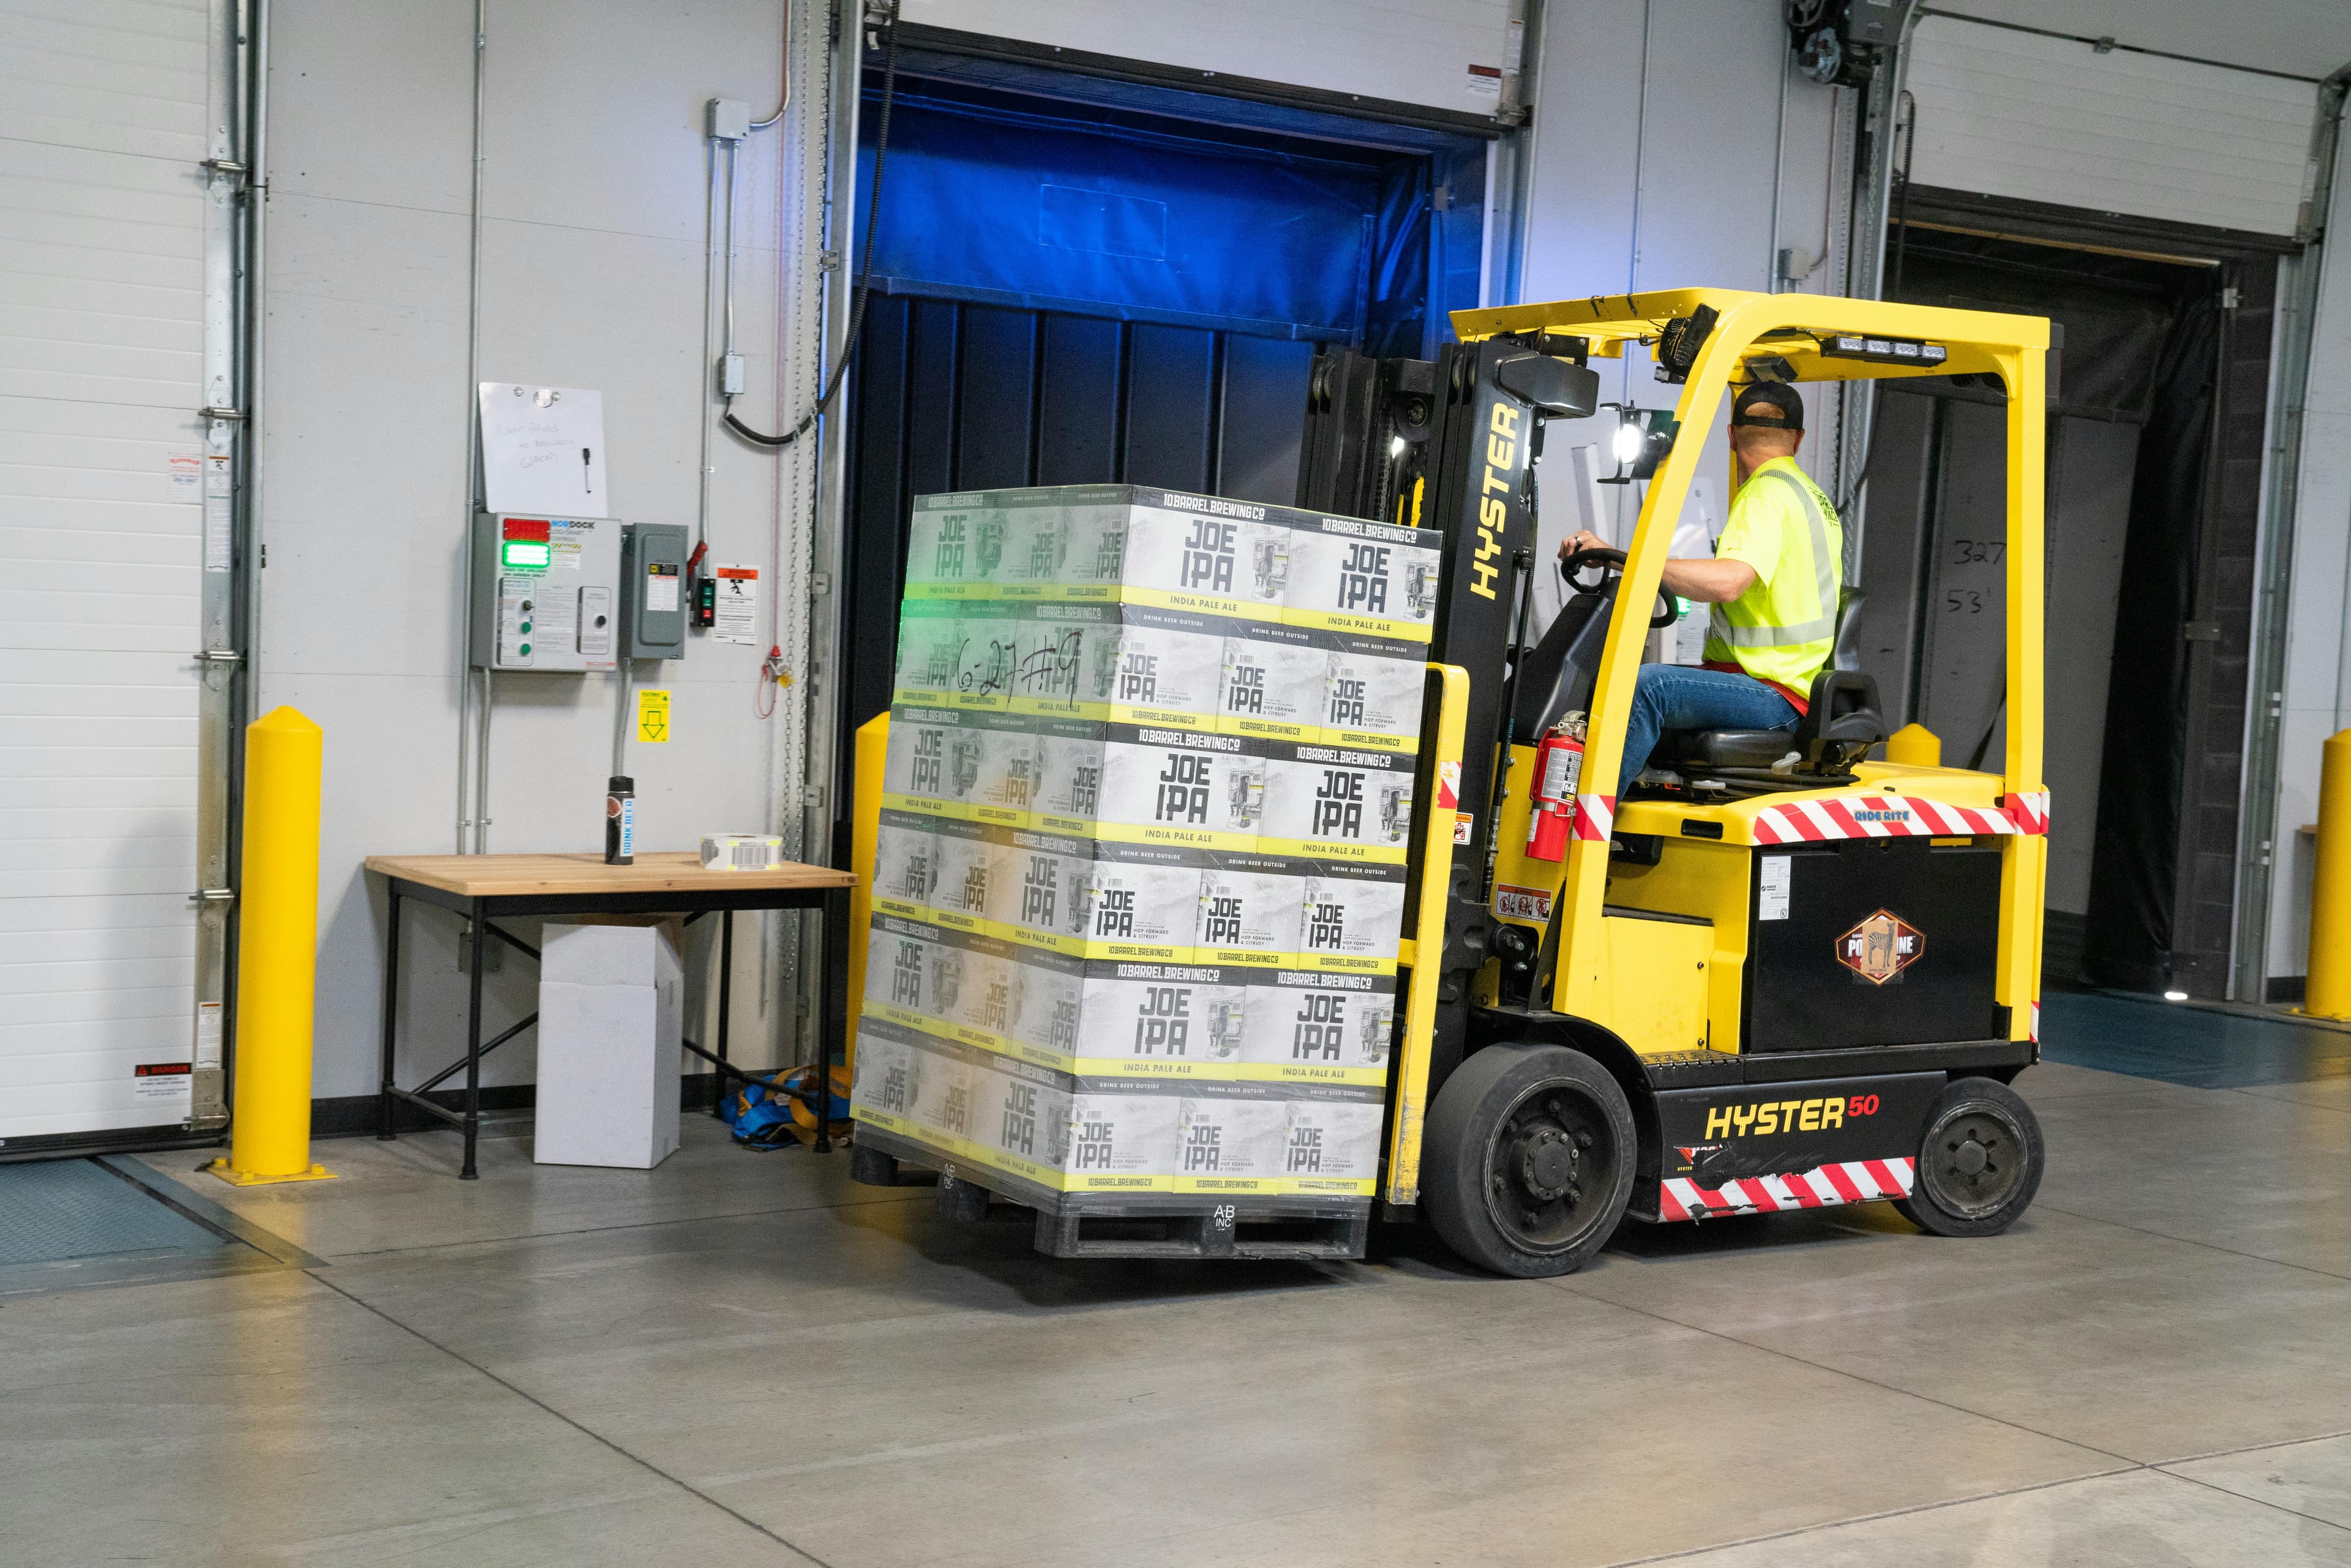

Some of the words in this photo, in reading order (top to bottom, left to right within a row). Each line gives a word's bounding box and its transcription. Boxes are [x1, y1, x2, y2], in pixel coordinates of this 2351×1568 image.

[1471, 402, 1519, 601] HYSTER
[939, 514, 967, 542] JOE
[1185, 520, 1237, 553] JOE
[935, 544, 964, 577] IPA
[1181, 550, 1234, 592] IPA
[1343, 543, 1390, 576] JOE
[1171, 596, 1196, 606] INDIA
[1199, 600, 1218, 609] PALE
[1338, 573, 1387, 613] IPA
[1329, 617, 1351, 626] INDIA
[1122, 654, 1158, 676] JOE
[1231, 666, 1265, 688] JOE
[1119, 675, 1155, 702] IPA
[1228, 686, 1262, 713] IPA
[1333, 679, 1365, 700] JOE
[1330, 699, 1363, 726] IPA
[915, 729, 942, 757] JOE
[911, 757, 940, 793] IPA
[1161, 754, 1212, 786] JOE
[1317, 770, 1365, 801] JOE
[1156, 784, 1209, 823] IPA
[1854, 811, 1881, 821] RIDE
[1884, 811, 1909, 821] RITE
[1313, 800, 1362, 838] IPA
[623, 827, 632, 855] DRINK
[1146, 830, 1171, 839] INDIA
[1026, 856, 1058, 888] JOE
[1022, 886, 1055, 926] IPA
[1100, 890, 1134, 910] JOE
[1208, 898, 1242, 918] JOE
[1312, 904, 1344, 924] JOE
[1097, 911, 1133, 937] IPA
[1205, 918, 1240, 943] IPA
[1309, 924, 1342, 949] IPA
[895, 940, 923, 972] JOE
[892, 968, 920, 1007] IPA
[1139, 987, 1191, 1017] JOE
[1297, 994, 1346, 1023] JOE
[1134, 1018, 1188, 1055] IPA
[1292, 1024, 1343, 1060] IPA
[1005, 1081, 1037, 1117] JOE
[1705, 1097, 1845, 1139] HYSTER
[1848, 1095, 1880, 1117] 50
[1002, 1111, 1034, 1155] IPA
[1079, 1123, 1114, 1142] JOE
[1188, 1126, 1221, 1145] JOE
[1290, 1128, 1323, 1147] JOE
[1076, 1144, 1112, 1168] IPA
[1185, 1147, 1220, 1171] IPA
[1287, 1148, 1321, 1172] IPA
[1215, 1218, 1231, 1227] INC
